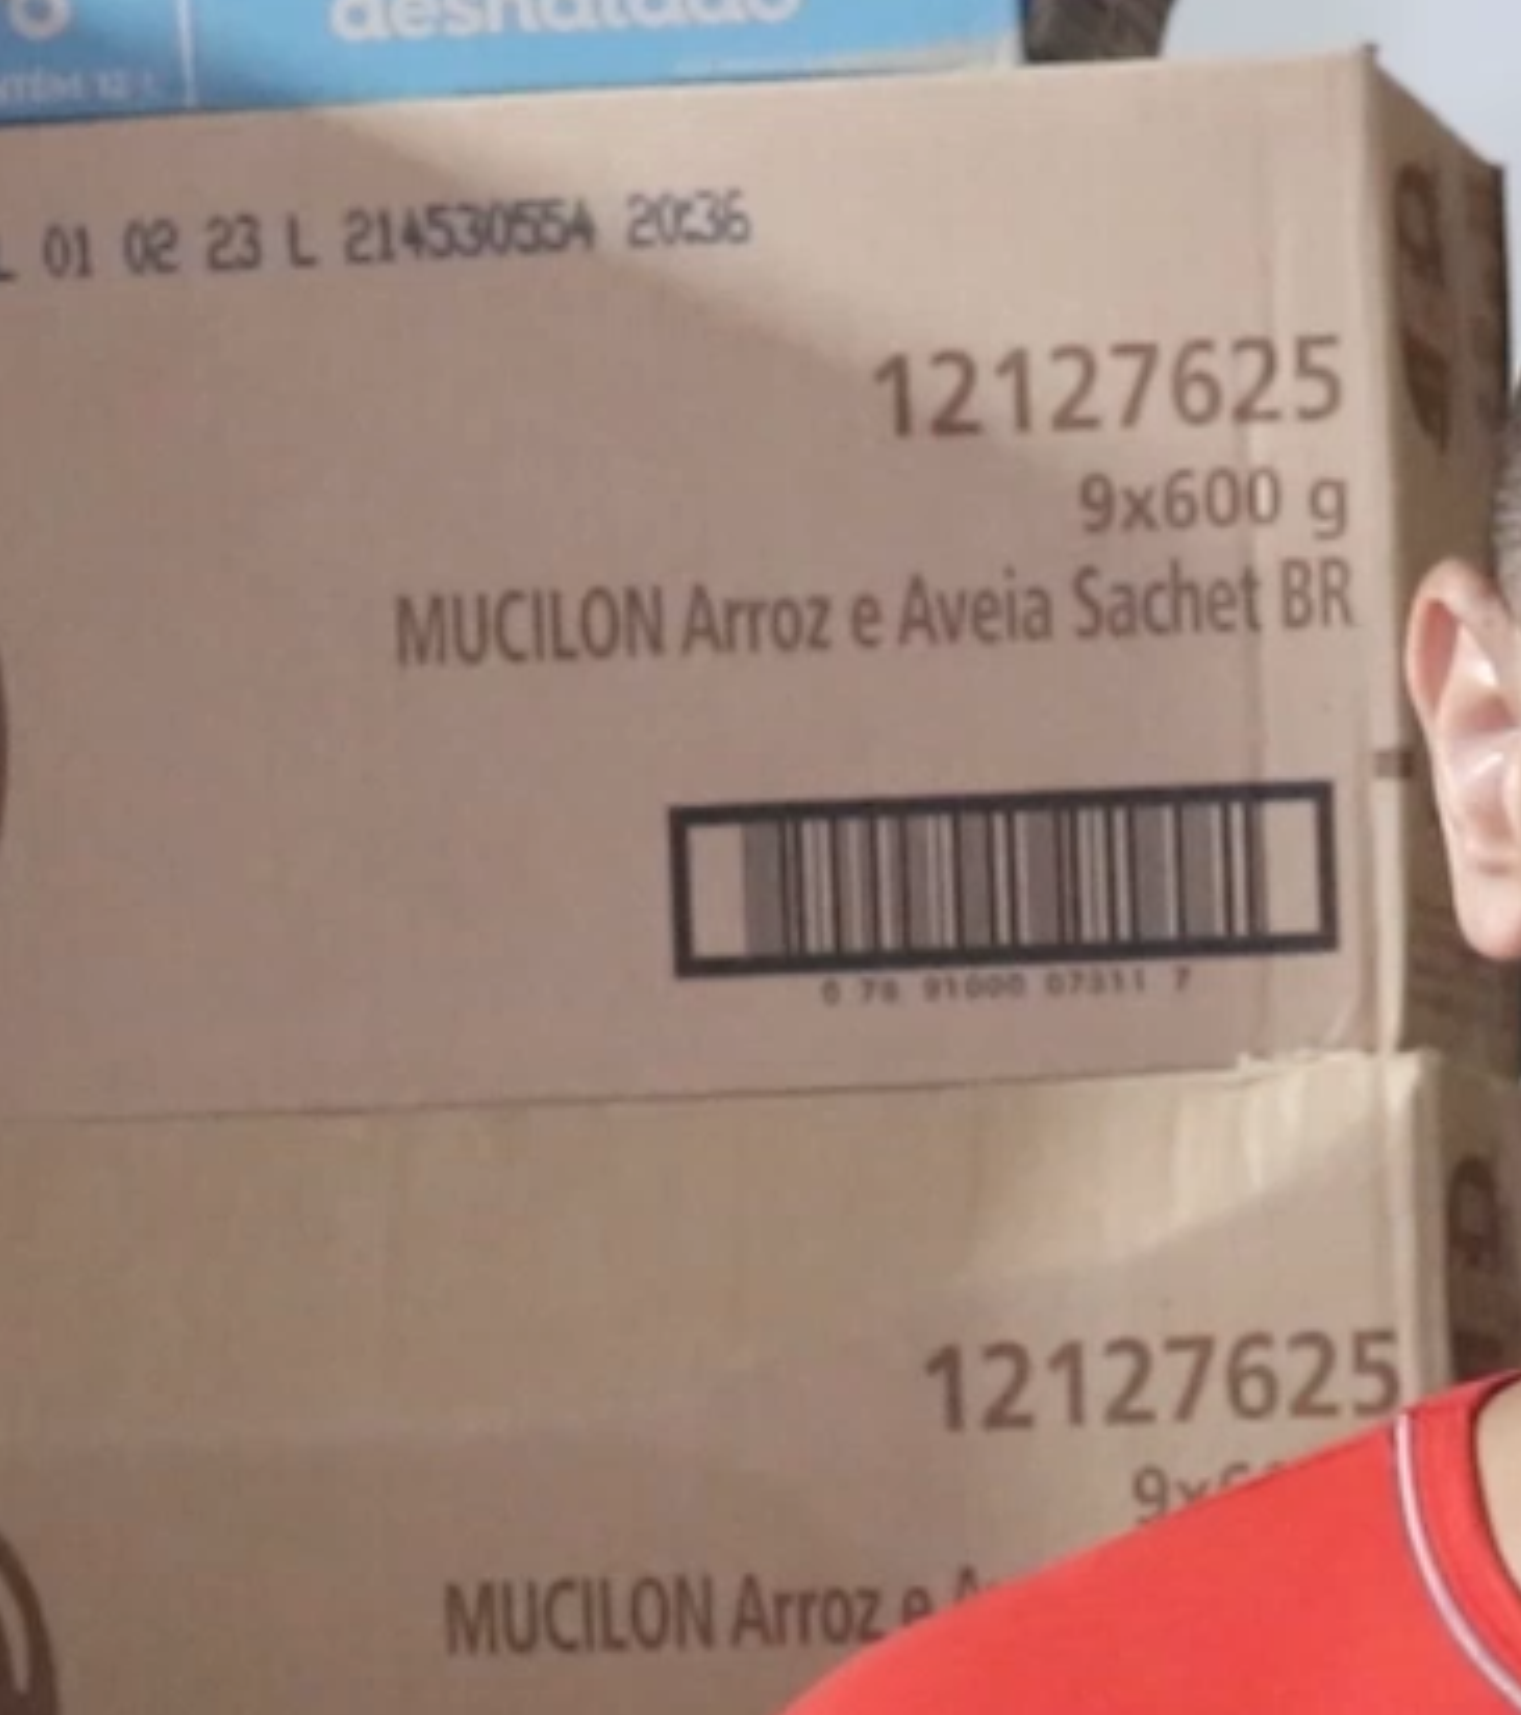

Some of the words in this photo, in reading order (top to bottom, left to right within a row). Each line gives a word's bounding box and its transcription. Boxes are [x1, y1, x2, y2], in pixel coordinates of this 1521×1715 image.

[43, 224, 93, 277] 01
[123, 221, 181, 275] 02
[206, 216, 263, 272] 23
[288, 215, 317, 267] L
[875, 333, 1344, 439] 12127625
[1081, 469, 1280, 534] 9x600
[1310, 476, 1346, 540] g
[395, 586, 665, 667] MUCILON
[681, 583, 832, 658] Arroz
[850, 595, 884, 648] e
[898, 567, 1053, 647] Aveia
[1072, 558, 1260, 639] Sachet
[1281, 556, 1353, 628] BR
[924, 1328, 1400, 1433] 12127625
[443, 1578, 713, 1658] MUCILON
[730, 1576, 884, 1648] Arroz
